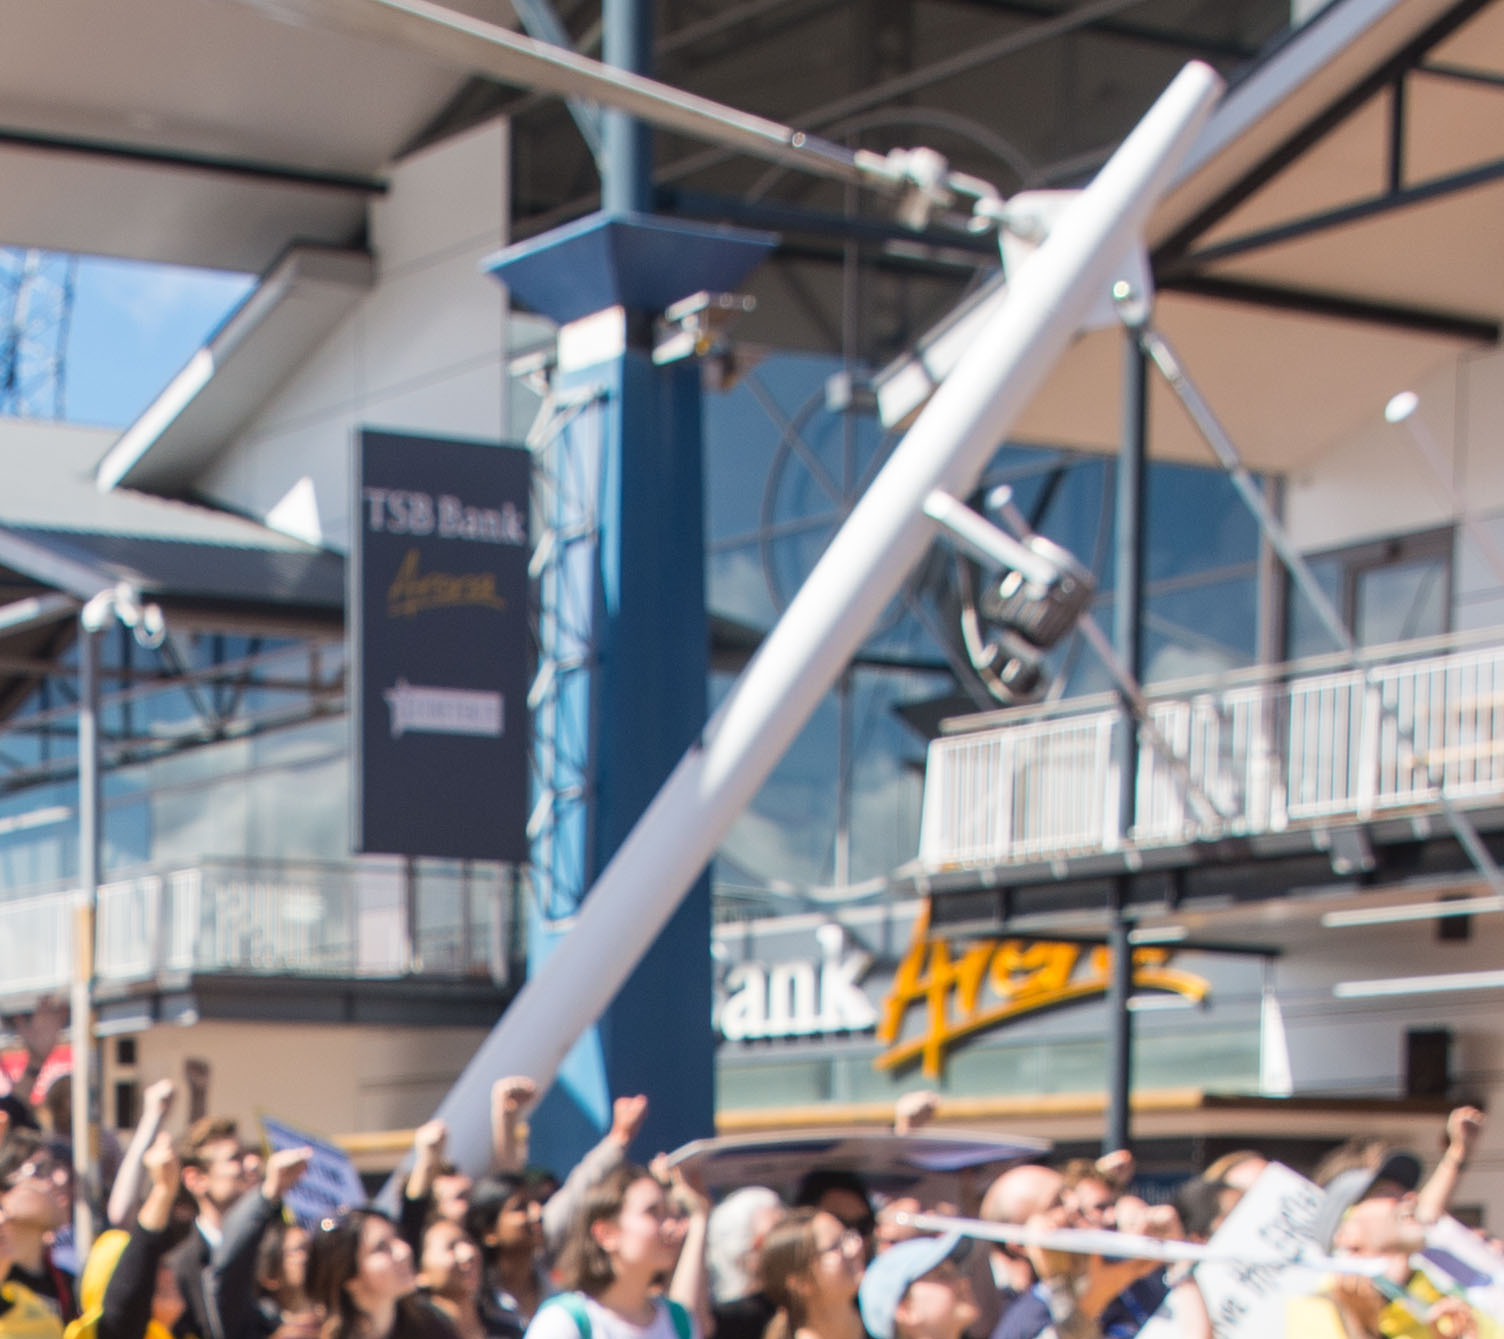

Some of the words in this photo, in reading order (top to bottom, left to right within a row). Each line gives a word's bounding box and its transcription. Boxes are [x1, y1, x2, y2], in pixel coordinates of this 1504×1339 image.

[362, 485, 434, 536] TSB
[438, 494, 526, 546] Bank
[712, 924, 880, 1041] ank
